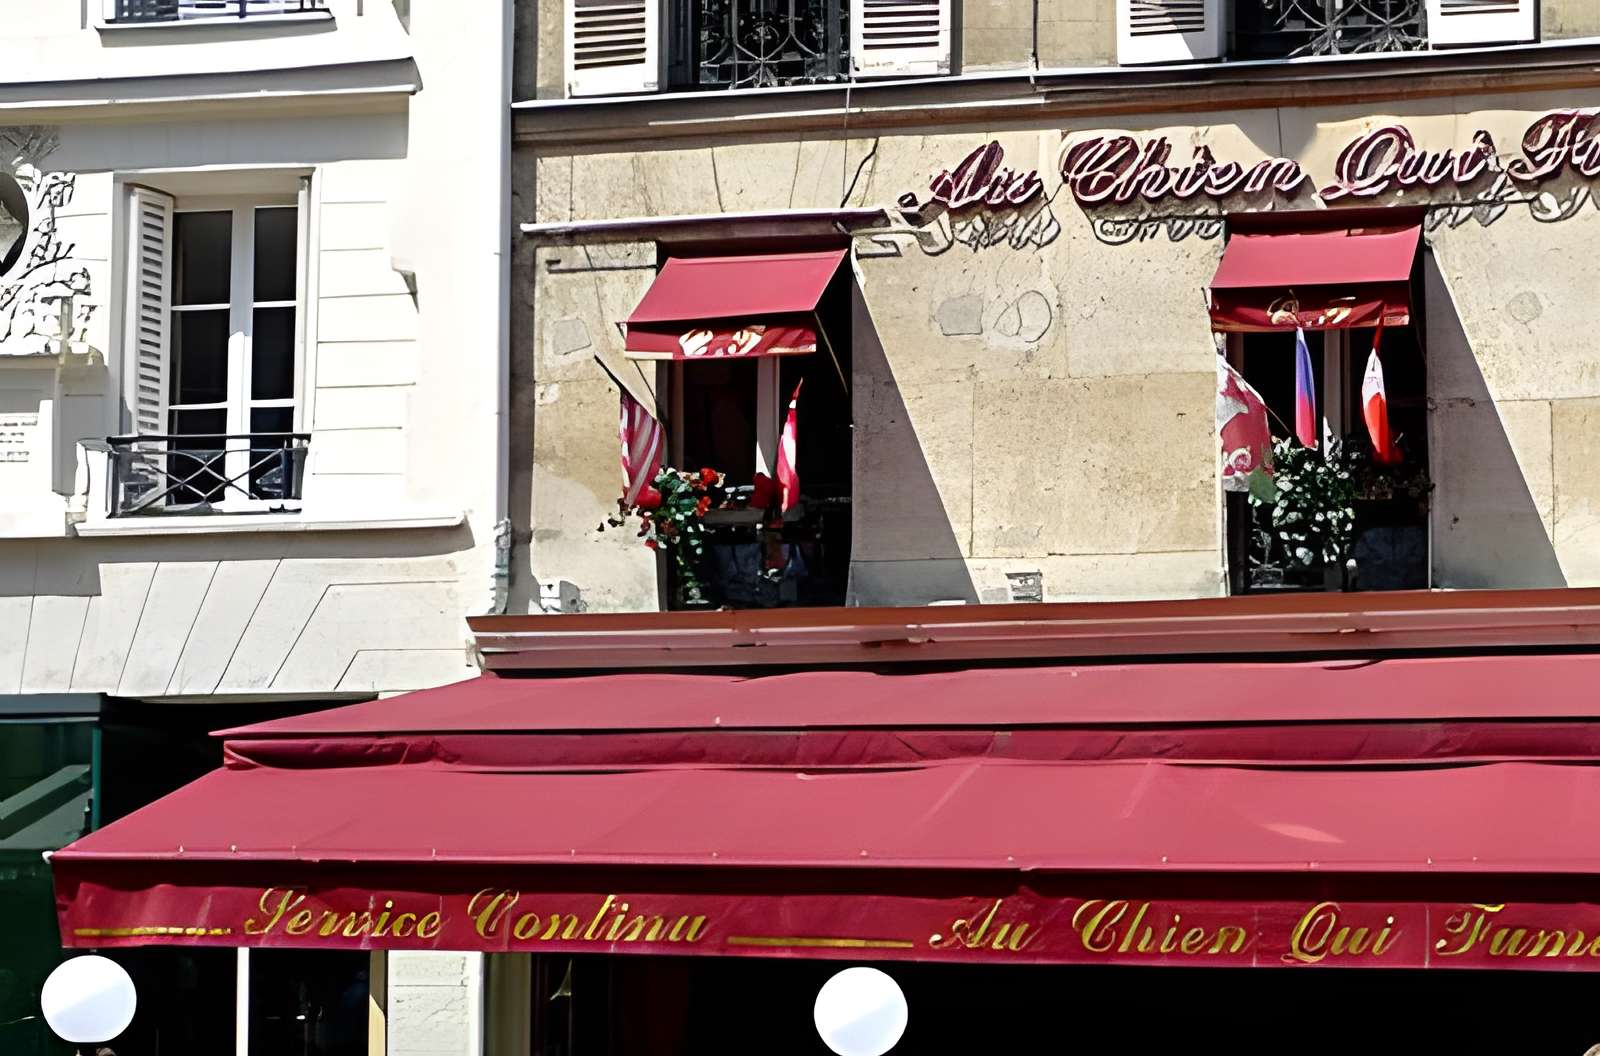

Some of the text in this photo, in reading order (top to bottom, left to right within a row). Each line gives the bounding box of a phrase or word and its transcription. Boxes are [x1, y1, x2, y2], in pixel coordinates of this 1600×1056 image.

[898, 140, 1044, 211] Au
[1063, 136, 1303, 206] Chien
[1319, 124, 1498, 199] Qui
[244, 886, 706, 943] Service Continu
[928, 899, 1034, 952] Au
[1072, 899, 1248, 955] Chien
[1280, 901, 1400, 964] Qui
